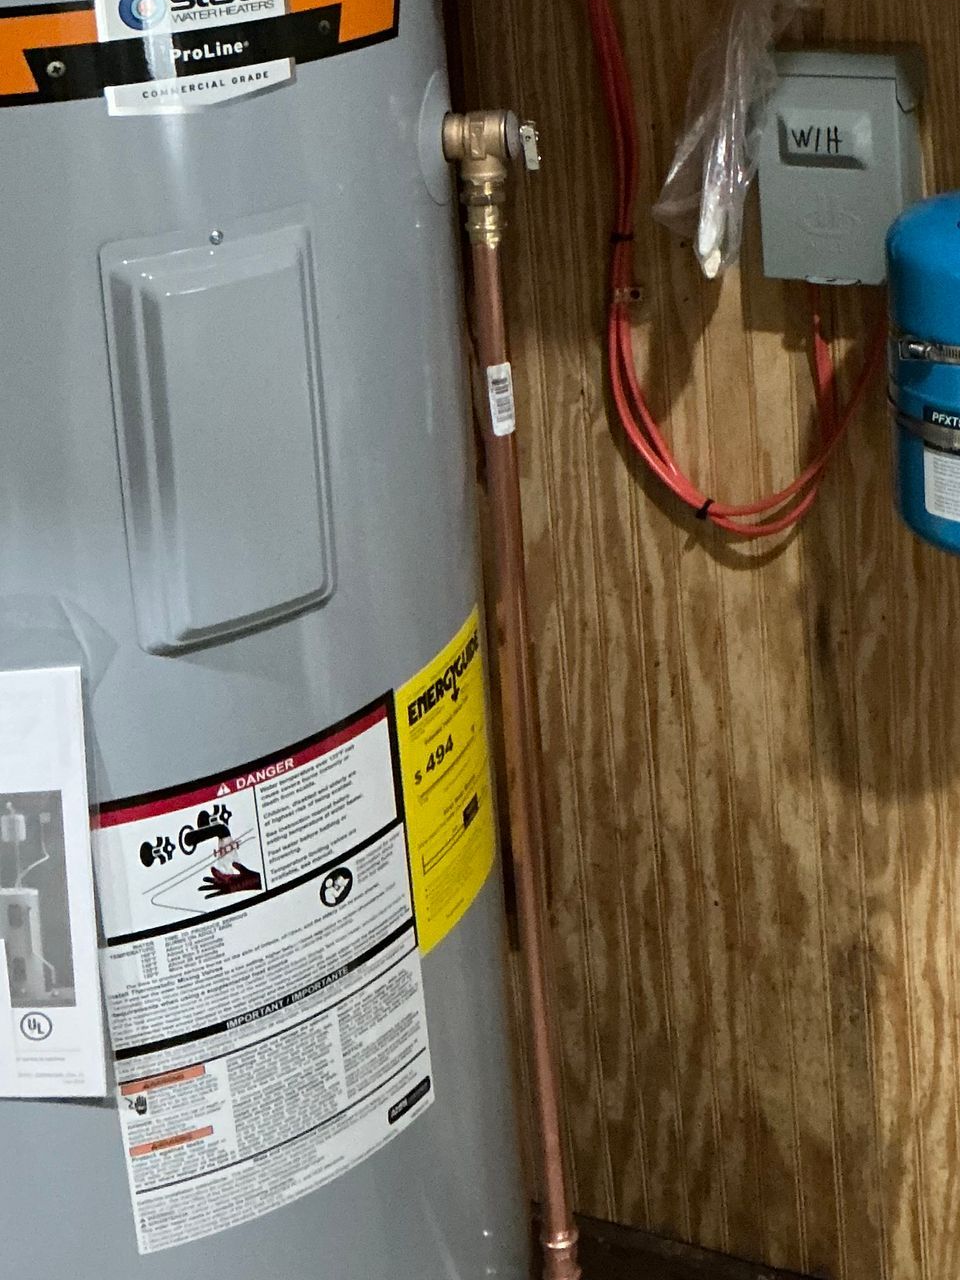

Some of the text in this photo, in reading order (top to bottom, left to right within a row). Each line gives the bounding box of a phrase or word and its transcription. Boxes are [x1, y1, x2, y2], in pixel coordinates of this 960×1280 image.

[171, 0, 275, 23] WATER HEATERS
[142, 71, 269, 99] COMMERCIAL GRADE
[791, 125, 844, 155] W/H
[236, 758, 295, 790] DANGER
[260, 782, 278, 794] Water
[279, 766, 315, 786] temperature
[261, 790, 279, 801] cause
[281, 780, 300, 792] severe
[301, 772, 318, 783] burns
[262, 797, 280, 808] death
[280, 791, 295, 800] from
[292, 792, 317, 807] disabled
[318, 786, 329, 794] and
[329, 776, 347, 789] elderly
[348, 770, 356, 778] are
[315, 793, 330, 804] being
[267, 833, 287, 845] setting
[289, 816, 323, 836] temperature
[331, 804, 345, 815] water
[279, 815, 310, 832] instruction
[311, 803, 332, 817] manual
[213, 841, 240, 857] HOT
[300, 831, 318, 842] before
[270, 855, 308, 874] Temperature
[226, 1000, 285, 1030] IMPORTANT
[291, 966, 349, 1002] IMPORTANTE
[27, 1018, 45, 1034] UL
